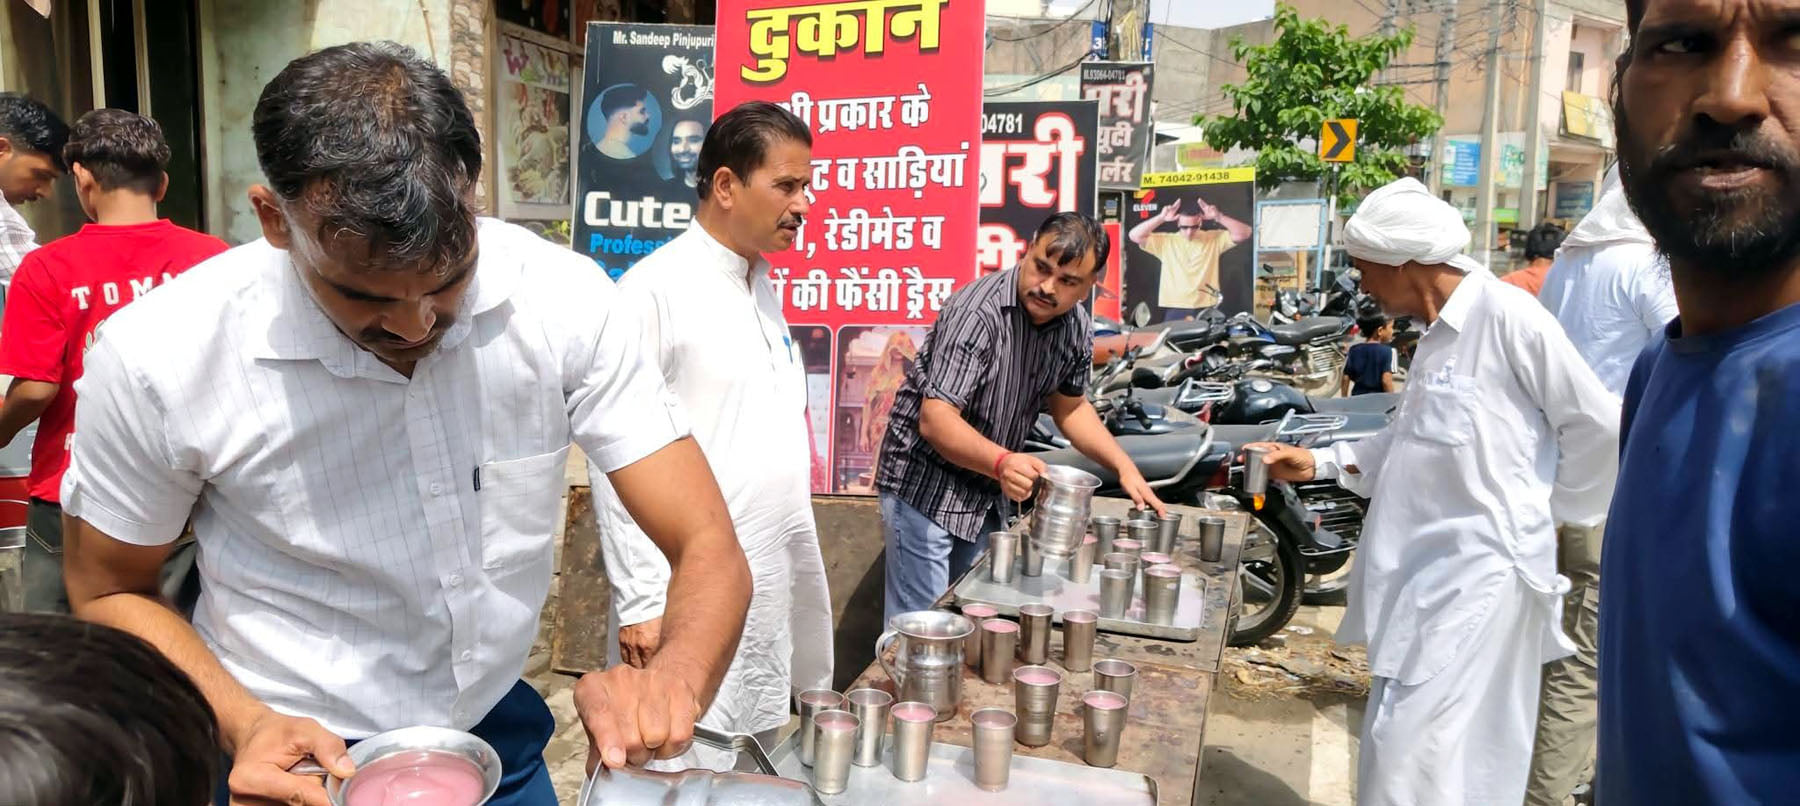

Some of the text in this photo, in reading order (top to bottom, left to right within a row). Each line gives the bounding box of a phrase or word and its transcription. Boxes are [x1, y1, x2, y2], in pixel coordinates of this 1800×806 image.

[613, 30, 628, 45] Mr.
[630, 31, 671, 49] Sandeep
[741, 0, 949, 83] दुकान
[818, 96, 896, 135] प्रकार
[900, 83, 932, 128] के
[836, 157, 859, 190] व
[862, 141, 970, 199] साड़ियां
[1143, 171, 1230, 186] M. 74042-91438
[584, 191, 691, 229] Cute
[824, 207, 916, 251] रेडीमेड
[922, 215, 945, 249] व
[590, 232, 672, 255] Profes
[72, 272, 182, 310] TOM
[792, 269, 831, 311] की
[835, 267, 902, 311] फैंसी
